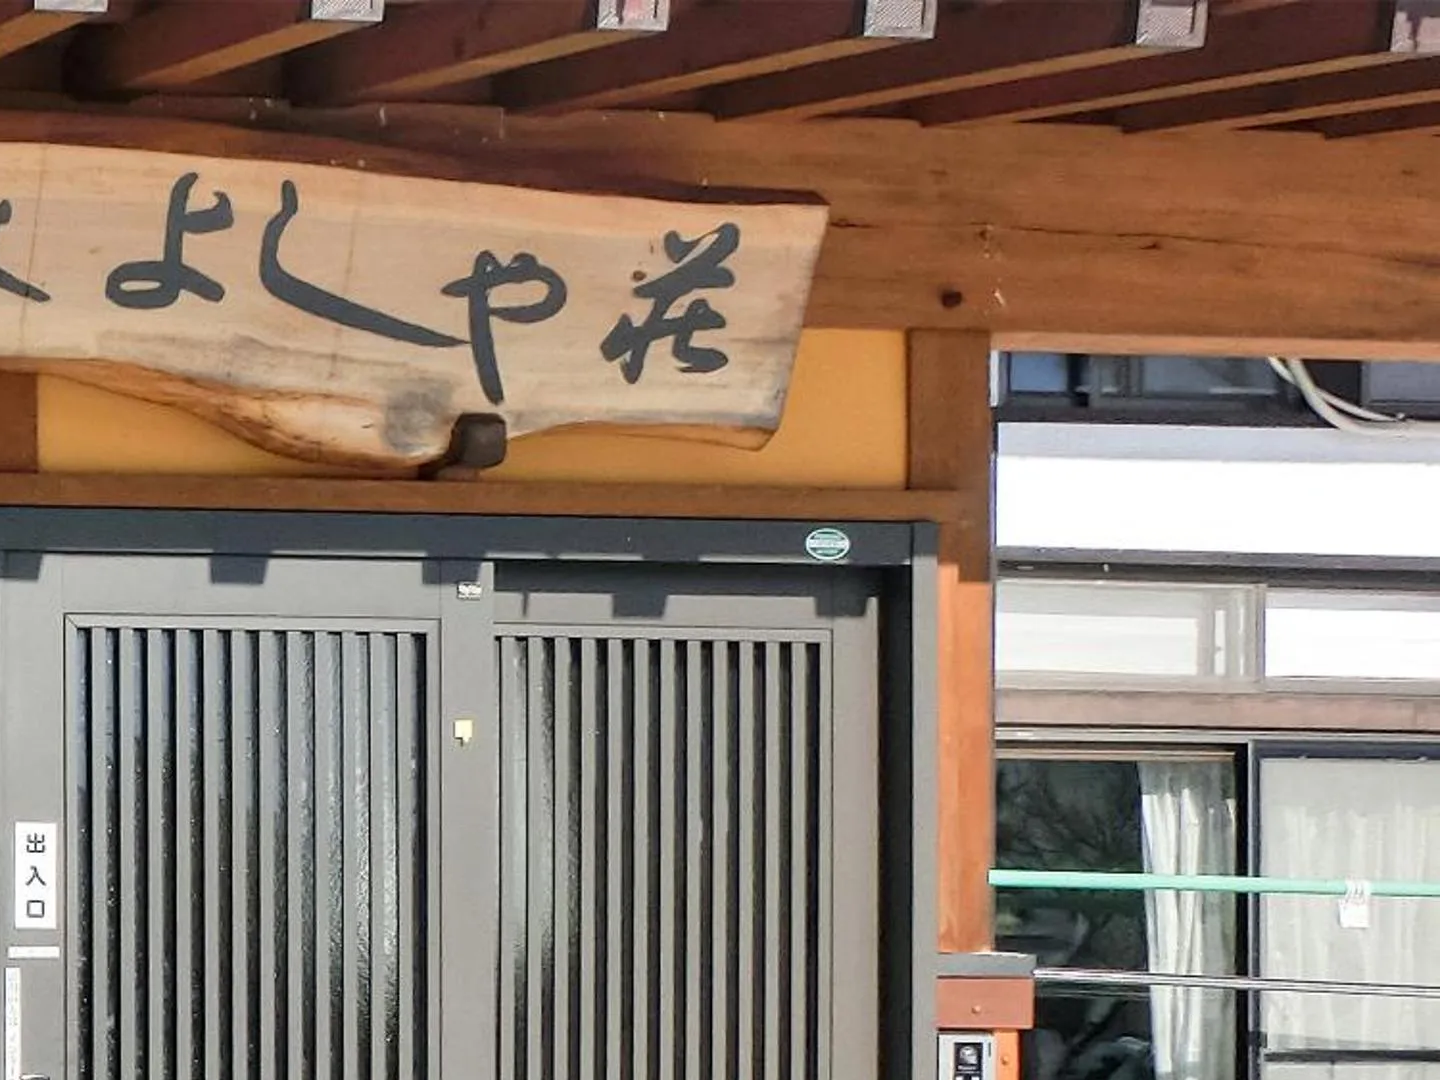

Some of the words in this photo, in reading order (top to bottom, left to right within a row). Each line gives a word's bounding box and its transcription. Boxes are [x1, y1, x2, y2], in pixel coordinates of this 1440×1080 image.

[104, 171, 742, 406] よしや荘
[25, 832, 47, 919] 出入口
